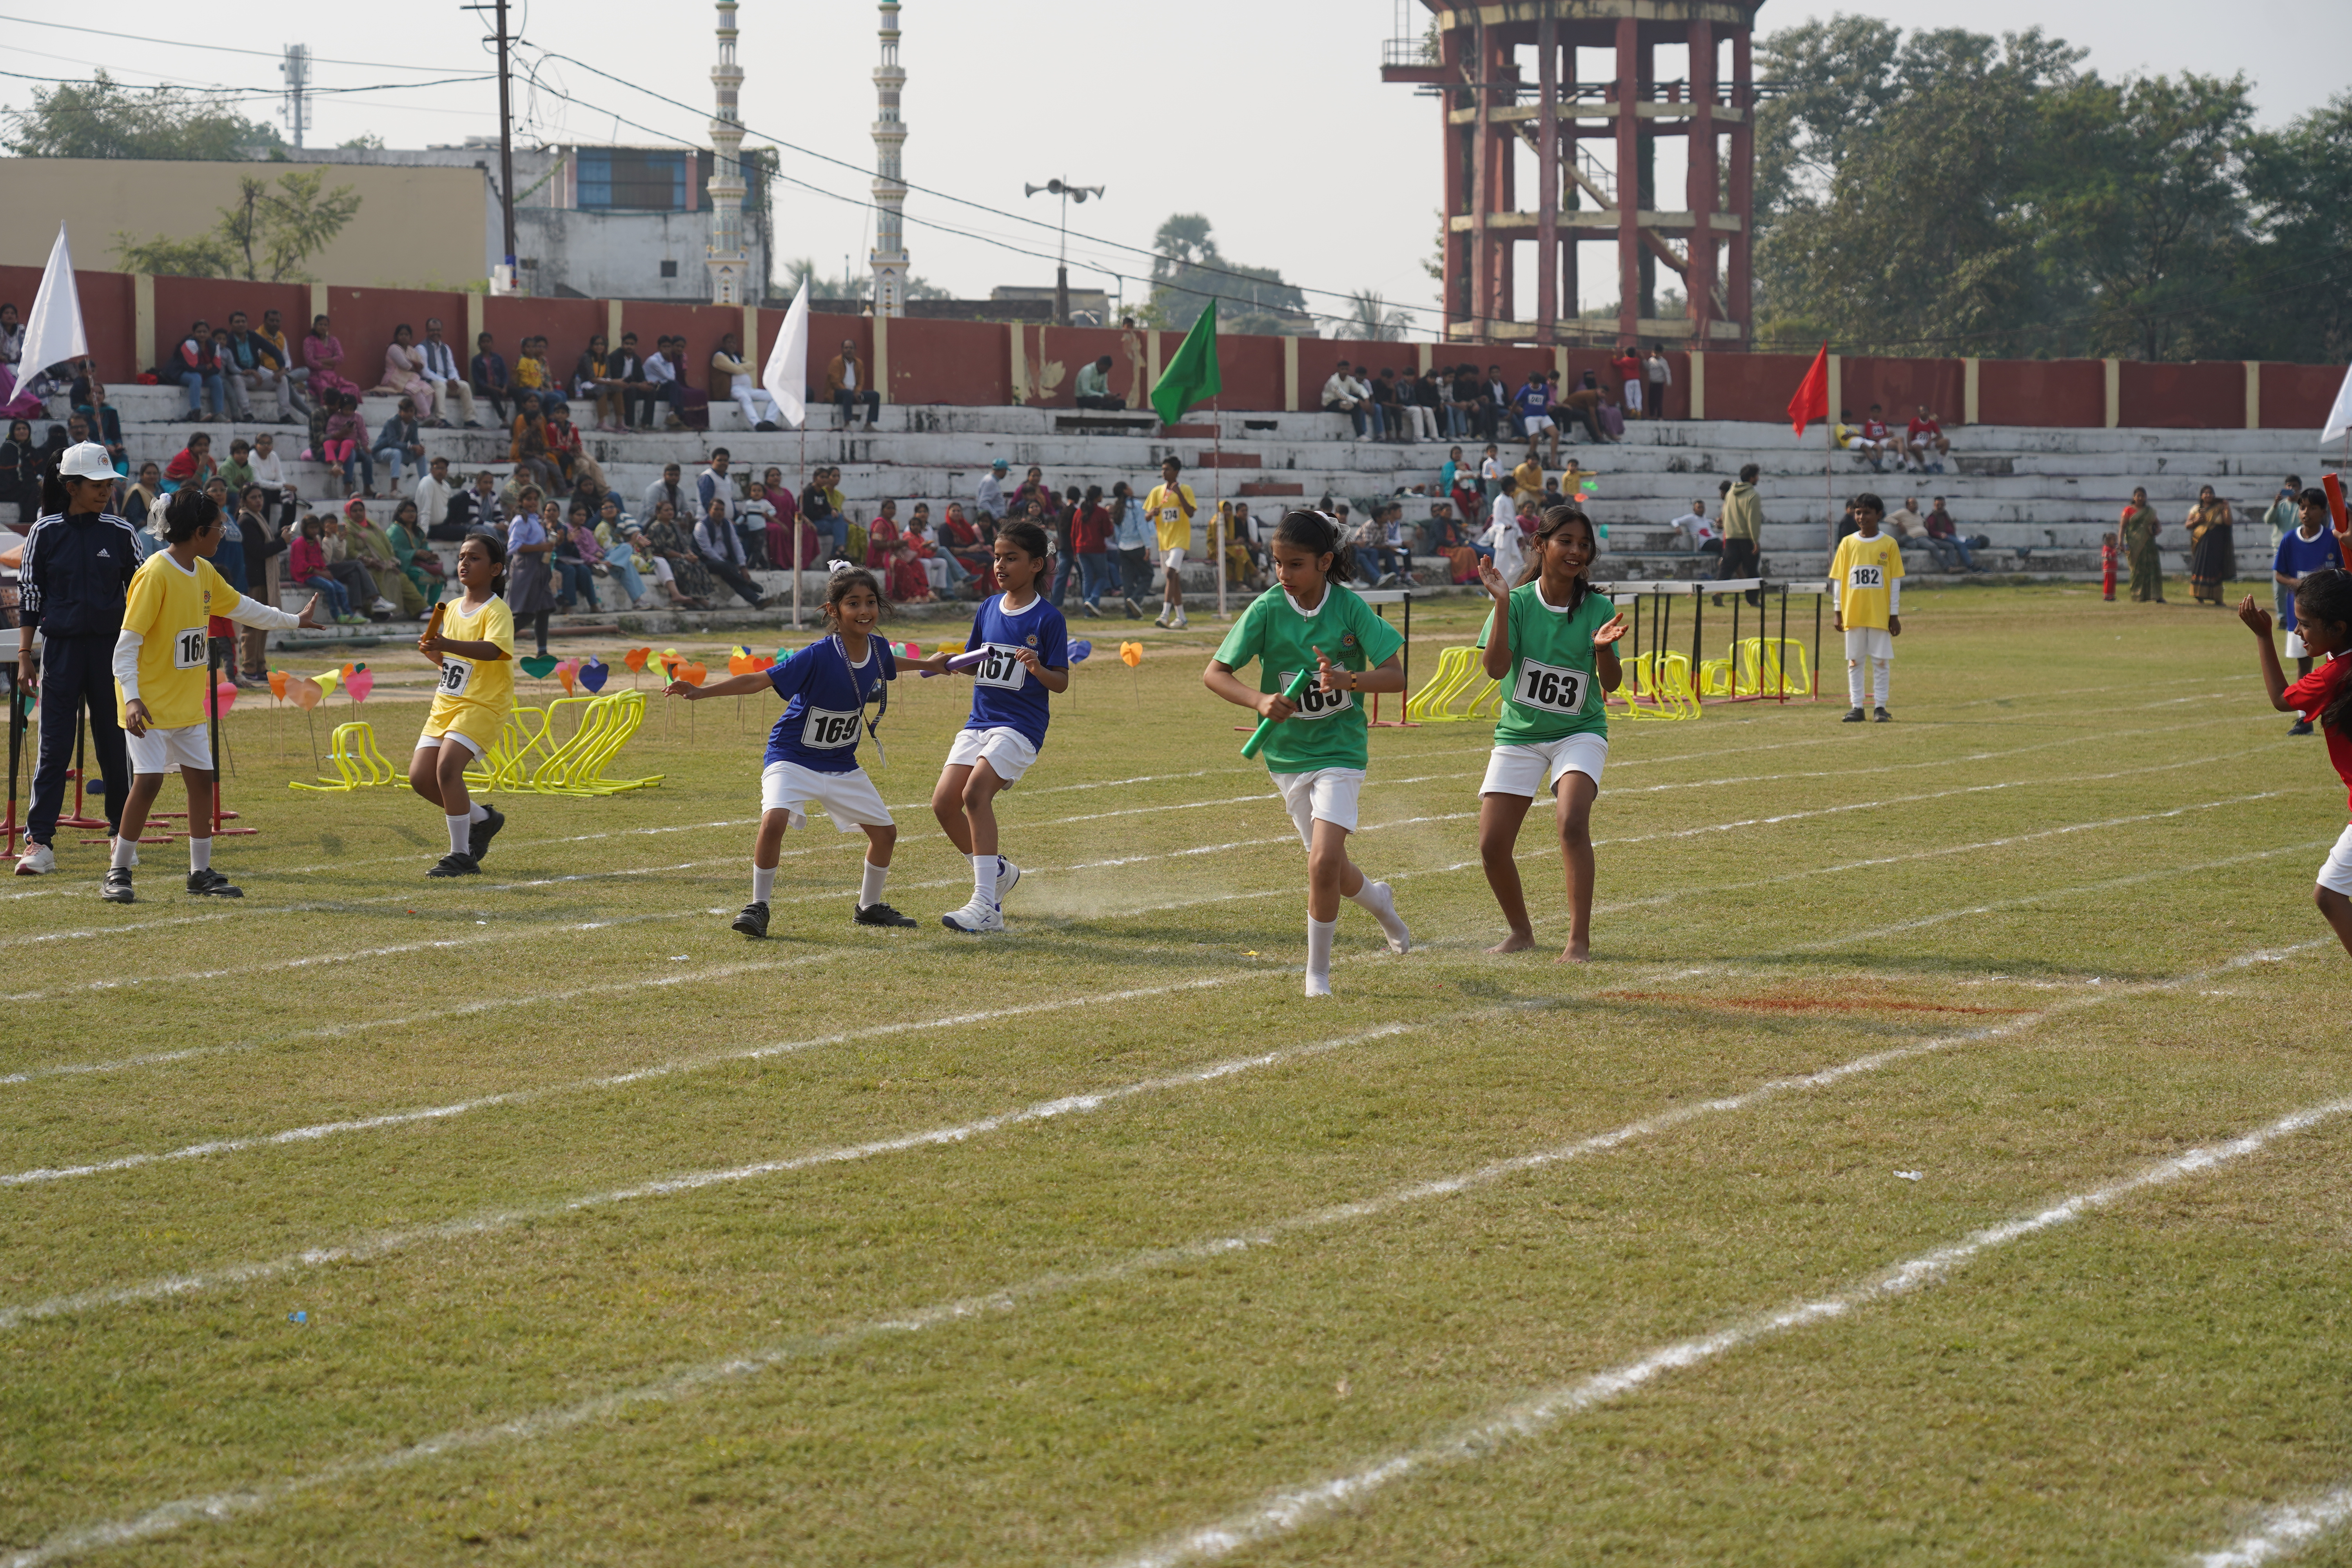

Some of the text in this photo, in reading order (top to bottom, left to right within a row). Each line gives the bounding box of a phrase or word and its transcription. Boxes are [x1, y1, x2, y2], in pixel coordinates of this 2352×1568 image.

[1854, 569, 1879, 584] 182
[181, 633, 205, 662] 168
[839, 641, 855, 676] INTERNATIONAL
[872, 639, 885, 673] INTERNATIONAL
[440, 662, 464, 689] 66
[980, 650, 1017, 681] 167
[1528, 670, 1578, 707] 163
[815, 715, 859, 743] 169
